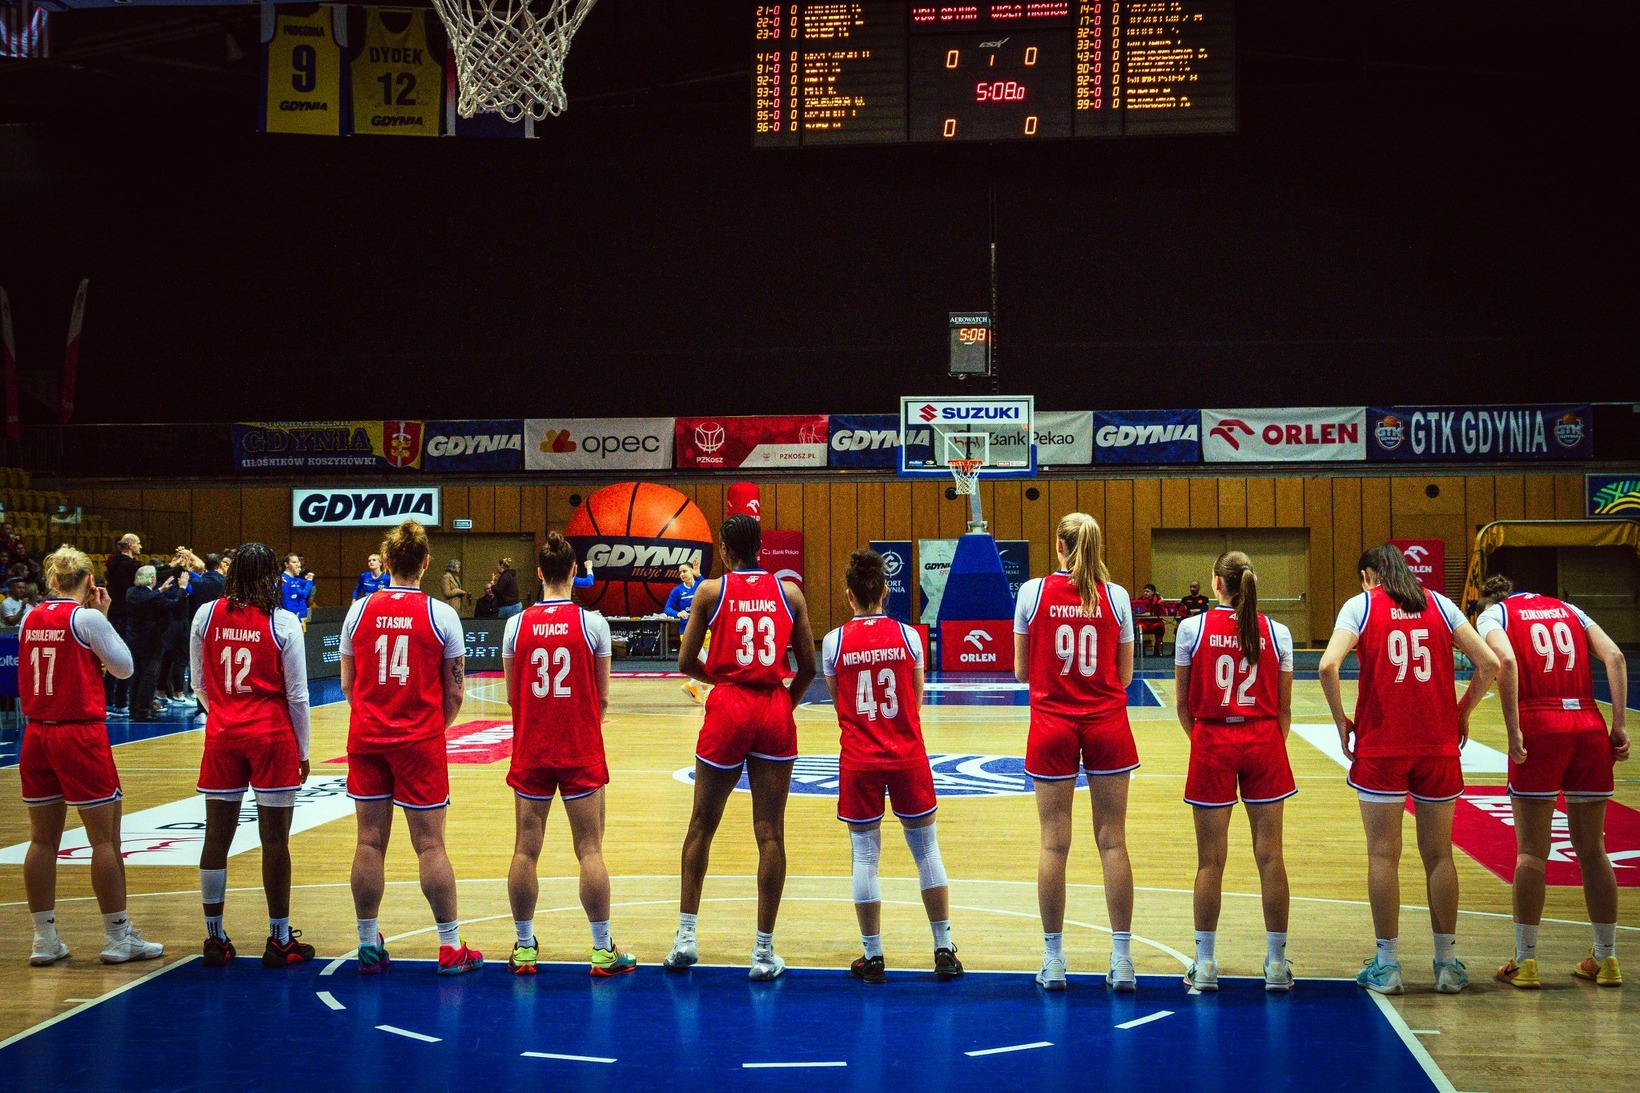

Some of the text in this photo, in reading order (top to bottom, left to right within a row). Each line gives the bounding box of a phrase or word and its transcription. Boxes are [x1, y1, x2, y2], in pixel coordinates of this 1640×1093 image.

[369, 47, 423, 64] DYDEK
[946, 50, 958, 68] 0
[1025, 47, 1037, 65] 0
[292, 45, 316, 92] 9
[377, 72, 416, 106] 12
[280, 101, 328, 111] GDYNIA
[371, 116, 422, 126] GDYNIA
[944, 119, 956, 137] 0
[1025, 117, 1037, 134] 0
[960, 329, 986, 341] 5:08
[942, 407, 1019, 419] SUZUKI
[242, 428, 373, 452] GDYNIA
[831, 430, 930, 451] GDYNIA
[989, 431, 1074, 445] Bank Pekao
[1096, 425, 1198, 447] GDYNIA
[1262, 423, 1358, 445] ORLEN
[1411, 410, 1547, 454] GTK GDYNIA
[427, 434, 521, 456] GDYNIA
[582, 436, 659, 458] opec
[308, 456, 376, 465] KOSZYKÓWKI
[300, 493, 433, 522] GDYNIA
[586, 544, 702, 568] GDYNIA
[729, 600, 776, 612] T. WILLIAMS
[376, 616, 413, 629] STASIUK
[532, 623, 568, 638] VUJACIC
[222, 628, 261, 642] WILLIAMS
[736, 616, 776, 666] 33
[1210, 634, 1266, 650] GILMAR
[843, 647, 906, 666] NIEMOJEWSKA
[960, 653, 996, 662] ORLEN
[1055, 624, 1098, 677] 90
[1388, 629, 1431, 683] 95
[1530, 622, 1576, 672] 99
[220, 646, 252, 694] 12
[375, 634, 410, 685] 14
[30, 647, 56, 696] 17
[531, 647, 572, 698] 32
[1216, 654, 1258, 706] 92
[856, 668, 899, 721] 43
